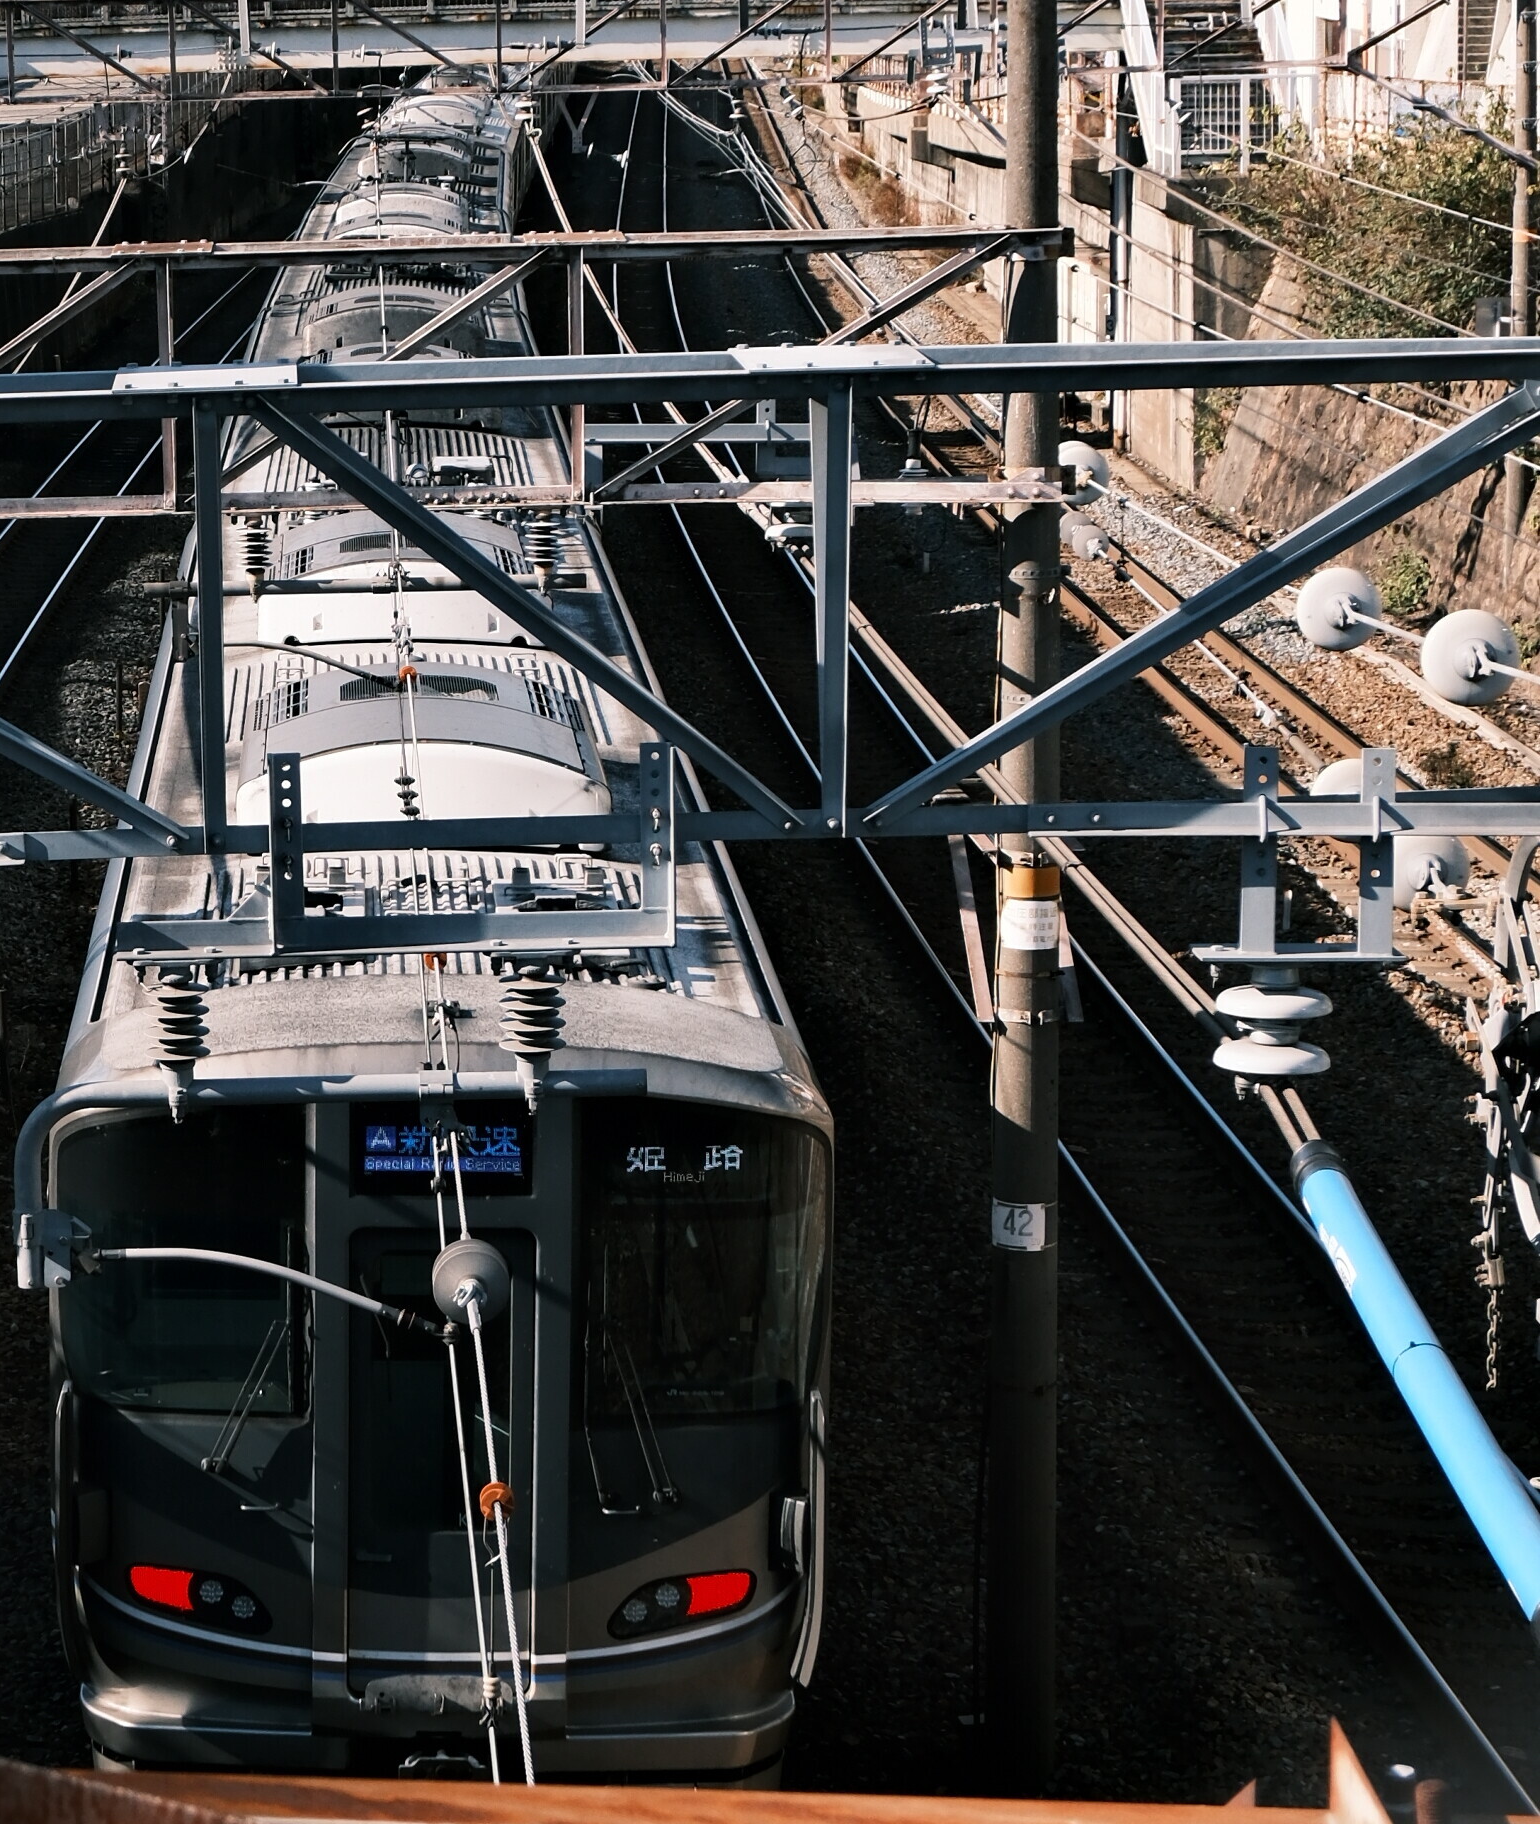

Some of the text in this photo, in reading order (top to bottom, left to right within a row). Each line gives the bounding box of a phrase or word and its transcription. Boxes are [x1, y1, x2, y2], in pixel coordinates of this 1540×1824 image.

[365, 1157, 414, 1171] Special
[465, 1157, 520, 1171] Service
[663, 1170, 705, 1183] Himeji
[1003, 1208, 1034, 1237] 42
